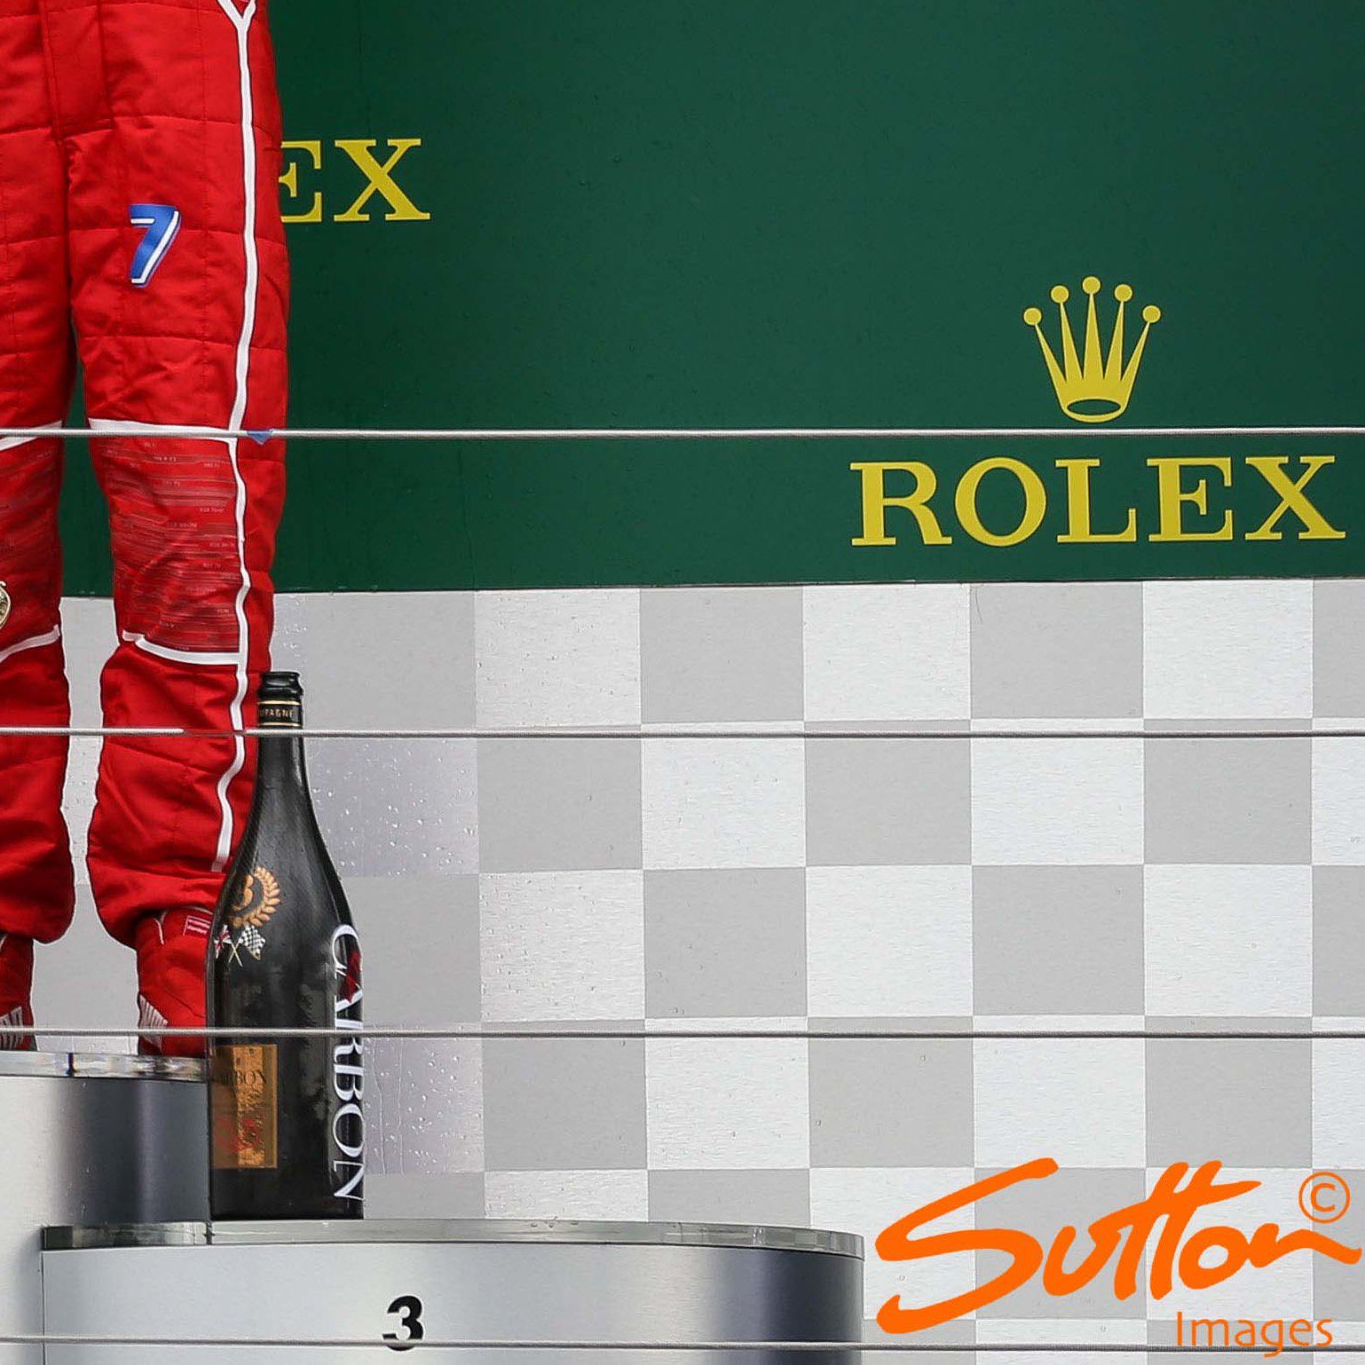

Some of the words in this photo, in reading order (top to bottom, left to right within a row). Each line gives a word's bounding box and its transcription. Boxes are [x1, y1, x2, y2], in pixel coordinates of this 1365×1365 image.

[128, 204, 181, 289] 7
[851, 455, 1345, 547] ROLEX
[382, 1294, 424, 1352] 3
